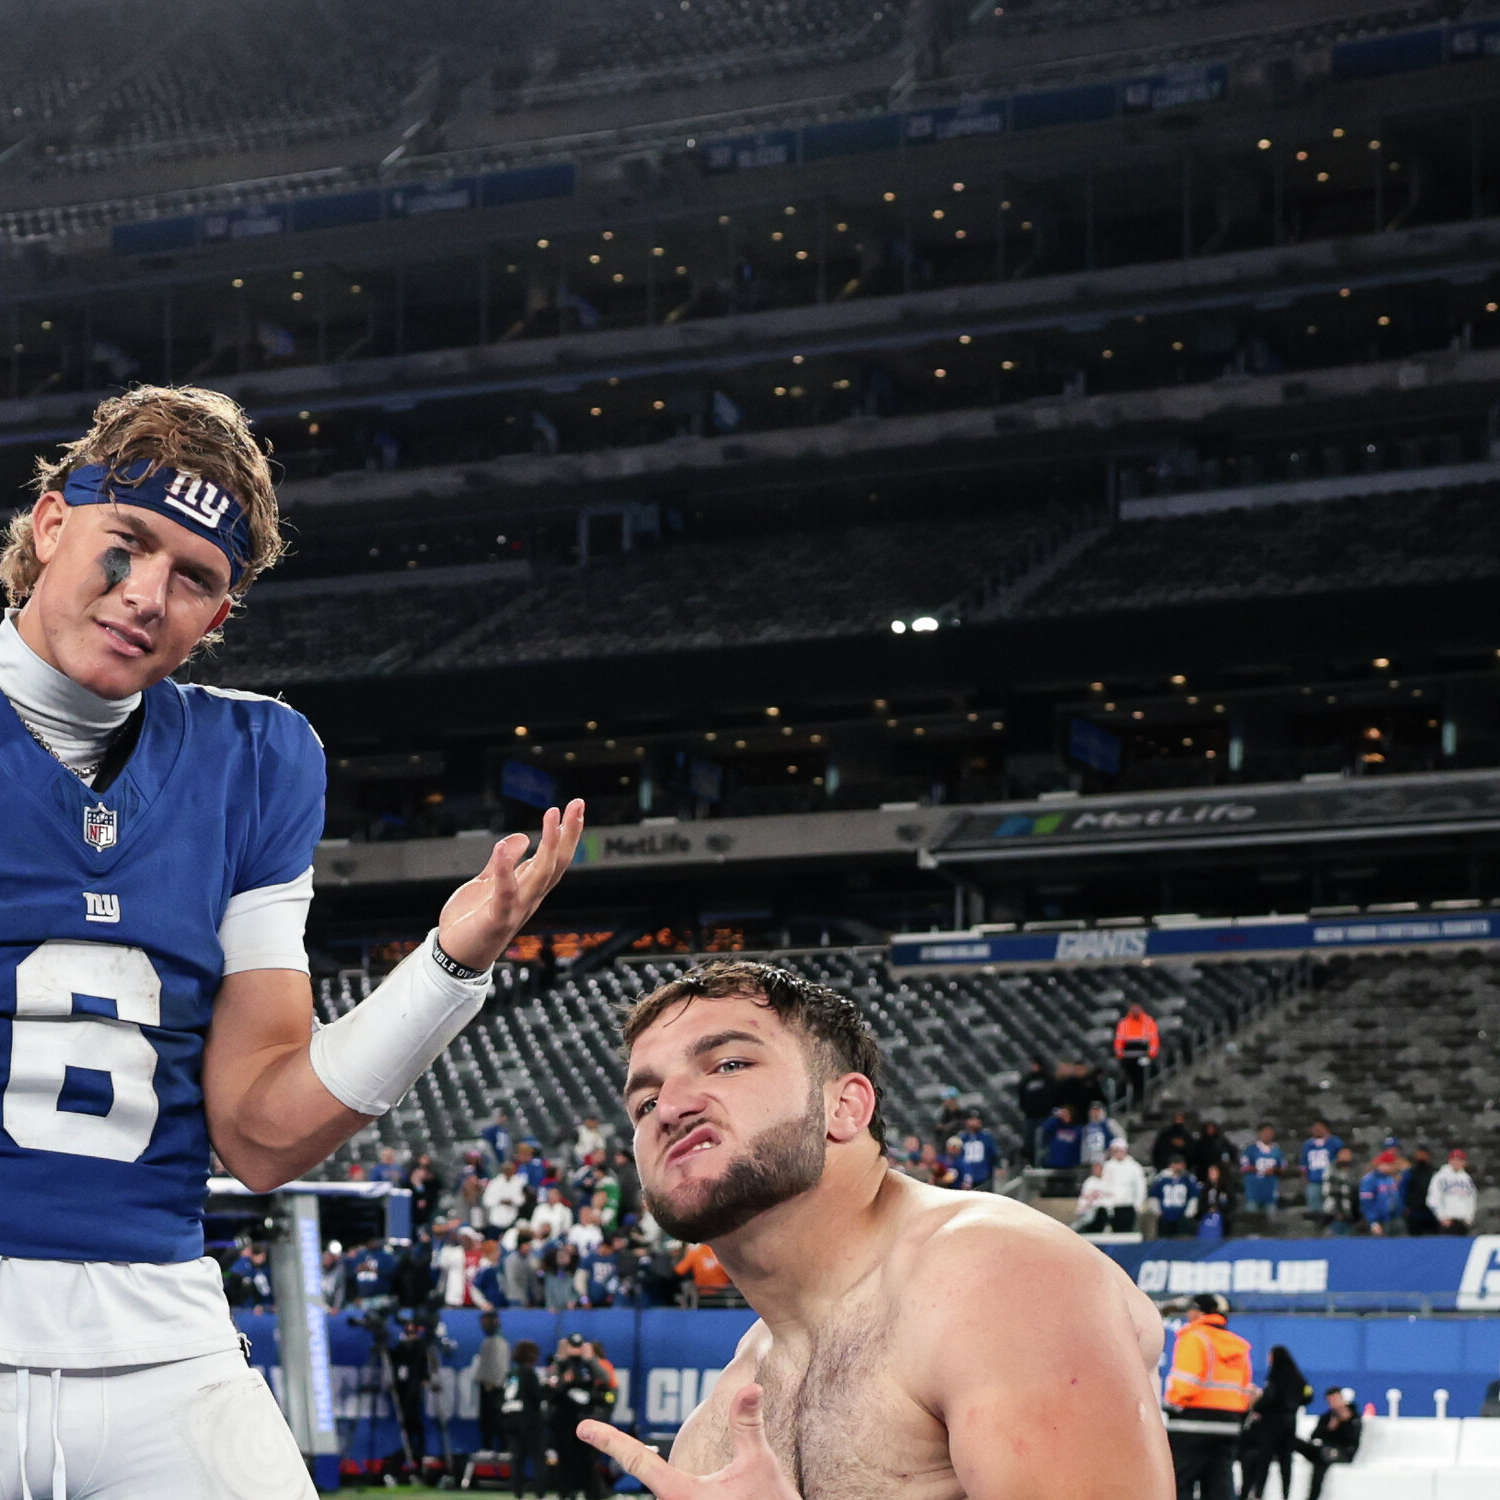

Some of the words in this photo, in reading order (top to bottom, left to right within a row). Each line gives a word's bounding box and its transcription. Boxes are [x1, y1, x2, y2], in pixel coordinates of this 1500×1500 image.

[89, 824, 112, 843] NFL
[2, 938, 162, 1164] 6
[1233, 1259, 1329, 1293] BLUE
